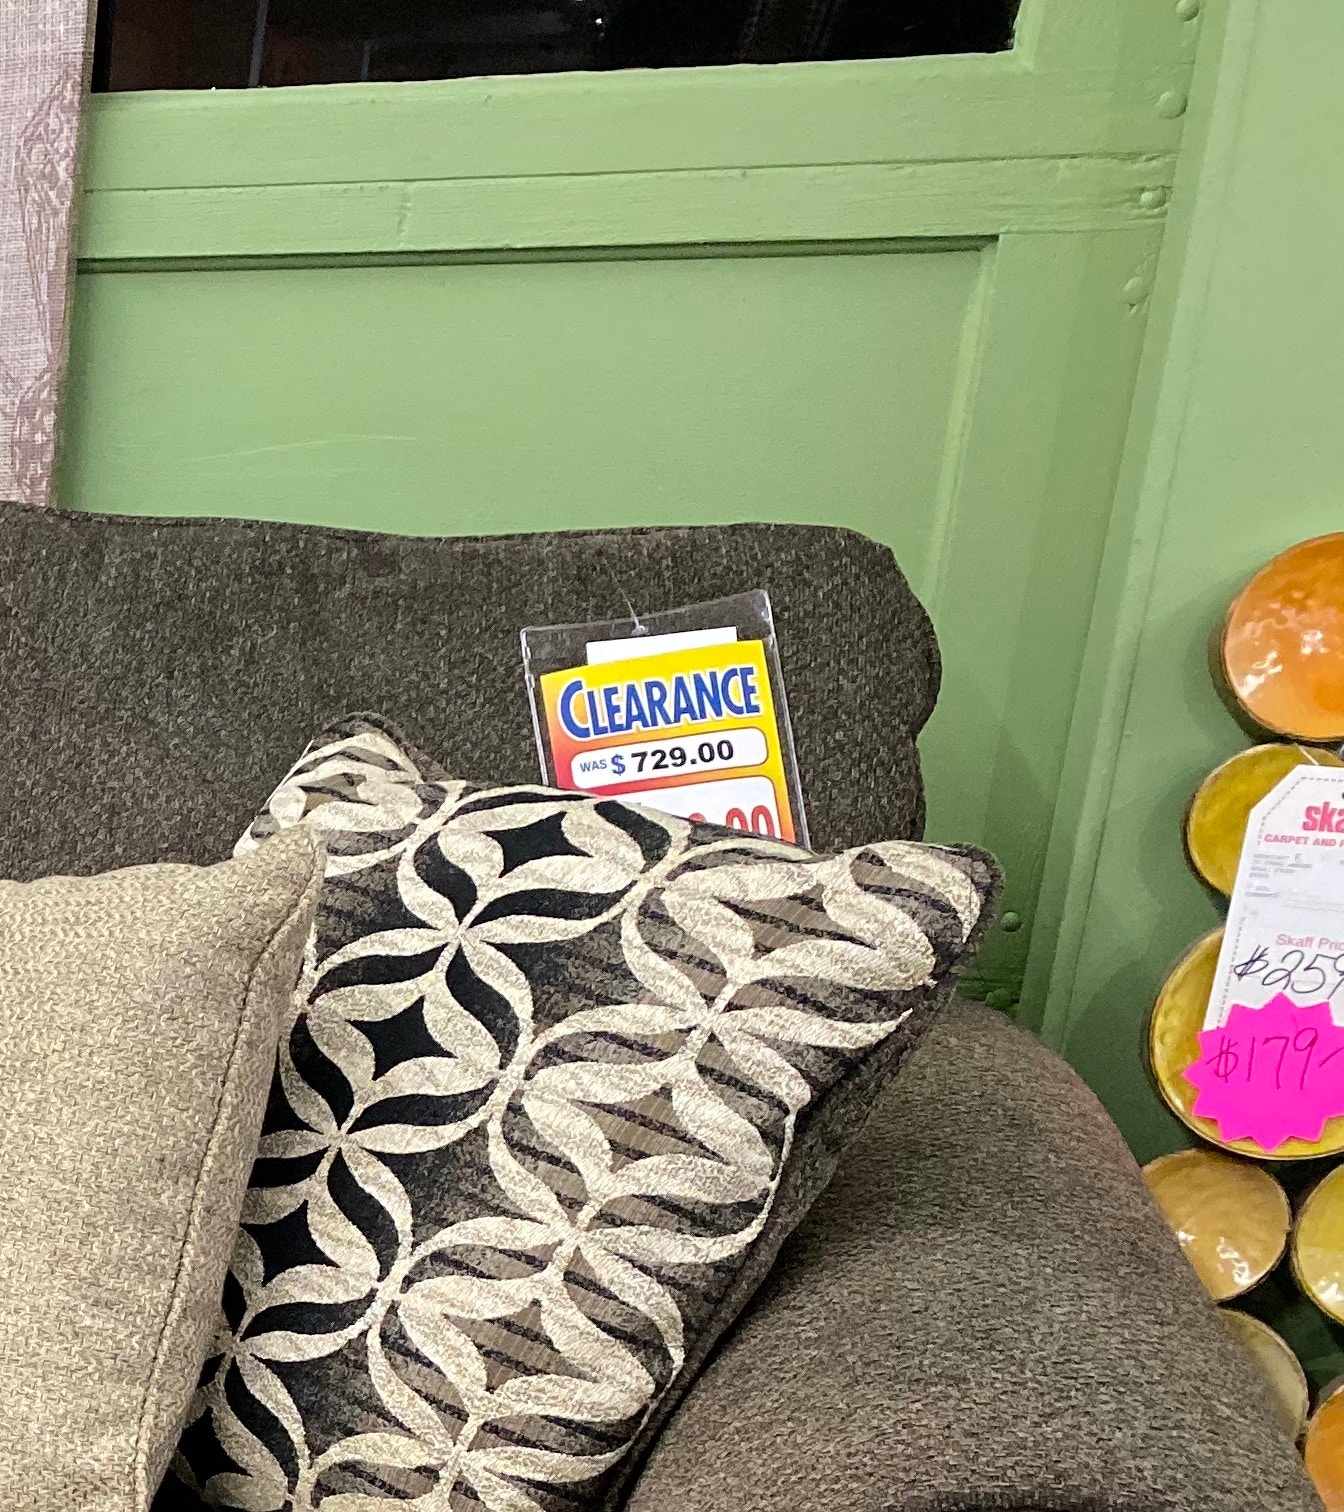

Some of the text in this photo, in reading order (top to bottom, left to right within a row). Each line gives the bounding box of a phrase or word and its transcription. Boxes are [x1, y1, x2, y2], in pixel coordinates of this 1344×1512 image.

[560, 667, 761, 738] CLEARANCE
[579, 759, 608, 773] WAS
[1264, 834, 1311, 846] CARPET
[1312, 838, 1337, 848] AND
